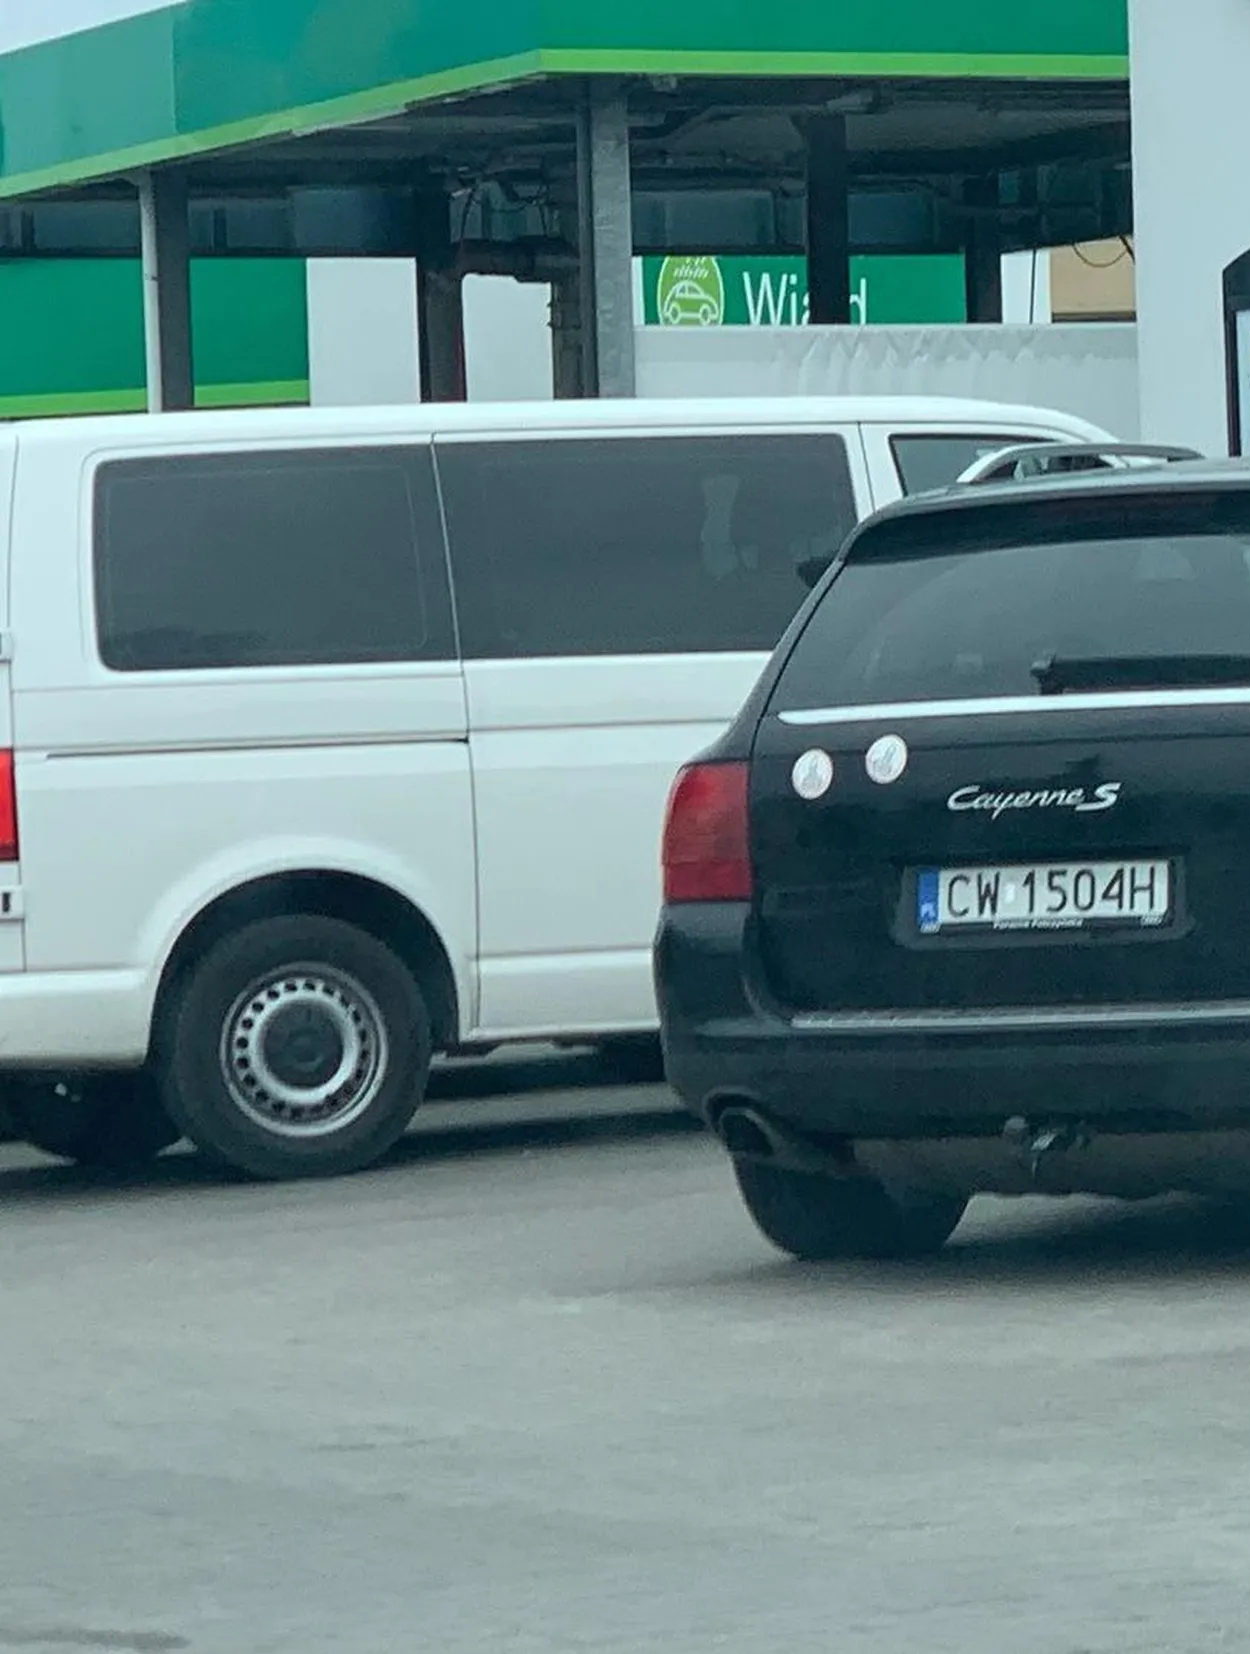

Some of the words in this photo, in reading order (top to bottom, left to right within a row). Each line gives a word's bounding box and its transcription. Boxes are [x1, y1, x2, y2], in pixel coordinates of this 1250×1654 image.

[947, 785, 1084, 820] Cayenne
[1075, 782, 1122, 811] S
[947, 872, 999, 917] CW
[1022, 866, 1155, 914] 1504H
